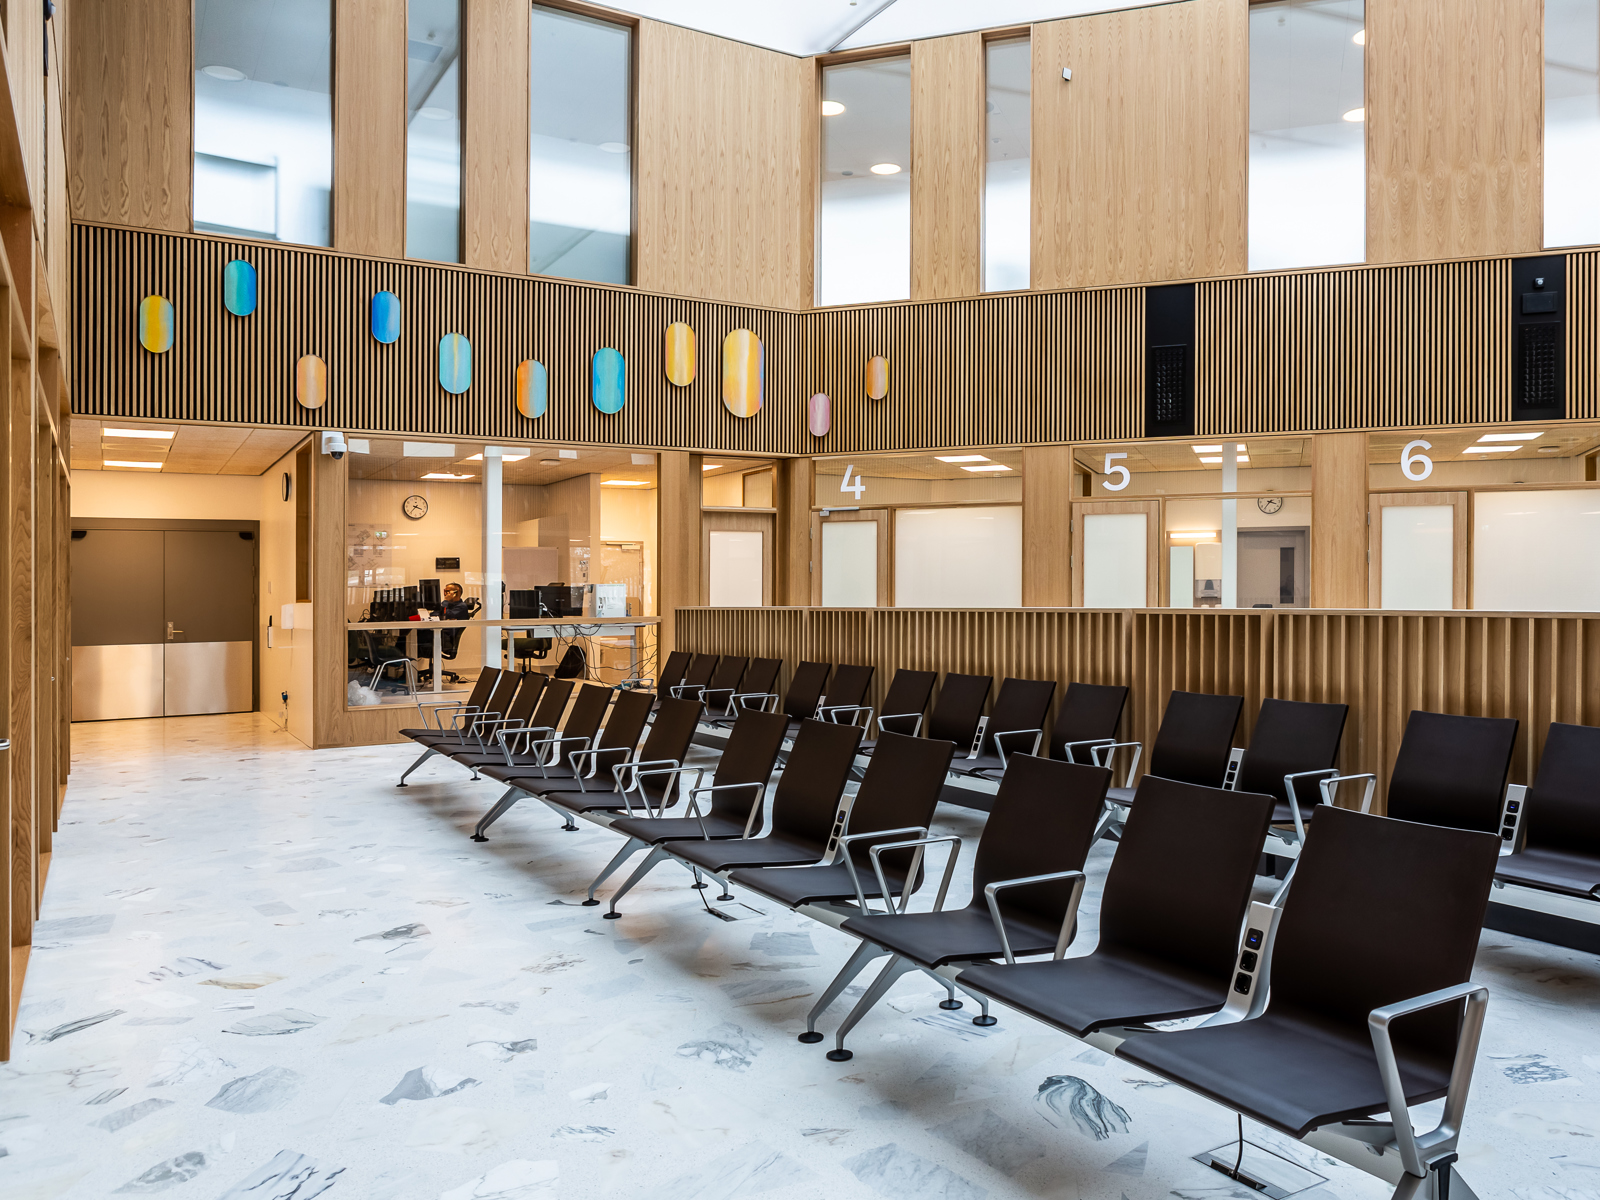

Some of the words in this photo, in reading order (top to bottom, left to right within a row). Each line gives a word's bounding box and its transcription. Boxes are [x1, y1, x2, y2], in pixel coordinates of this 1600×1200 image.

[1102, 452, 1131, 491] 5
[1400, 439, 1433, 481] 6
[840, 464, 866, 500] 4
